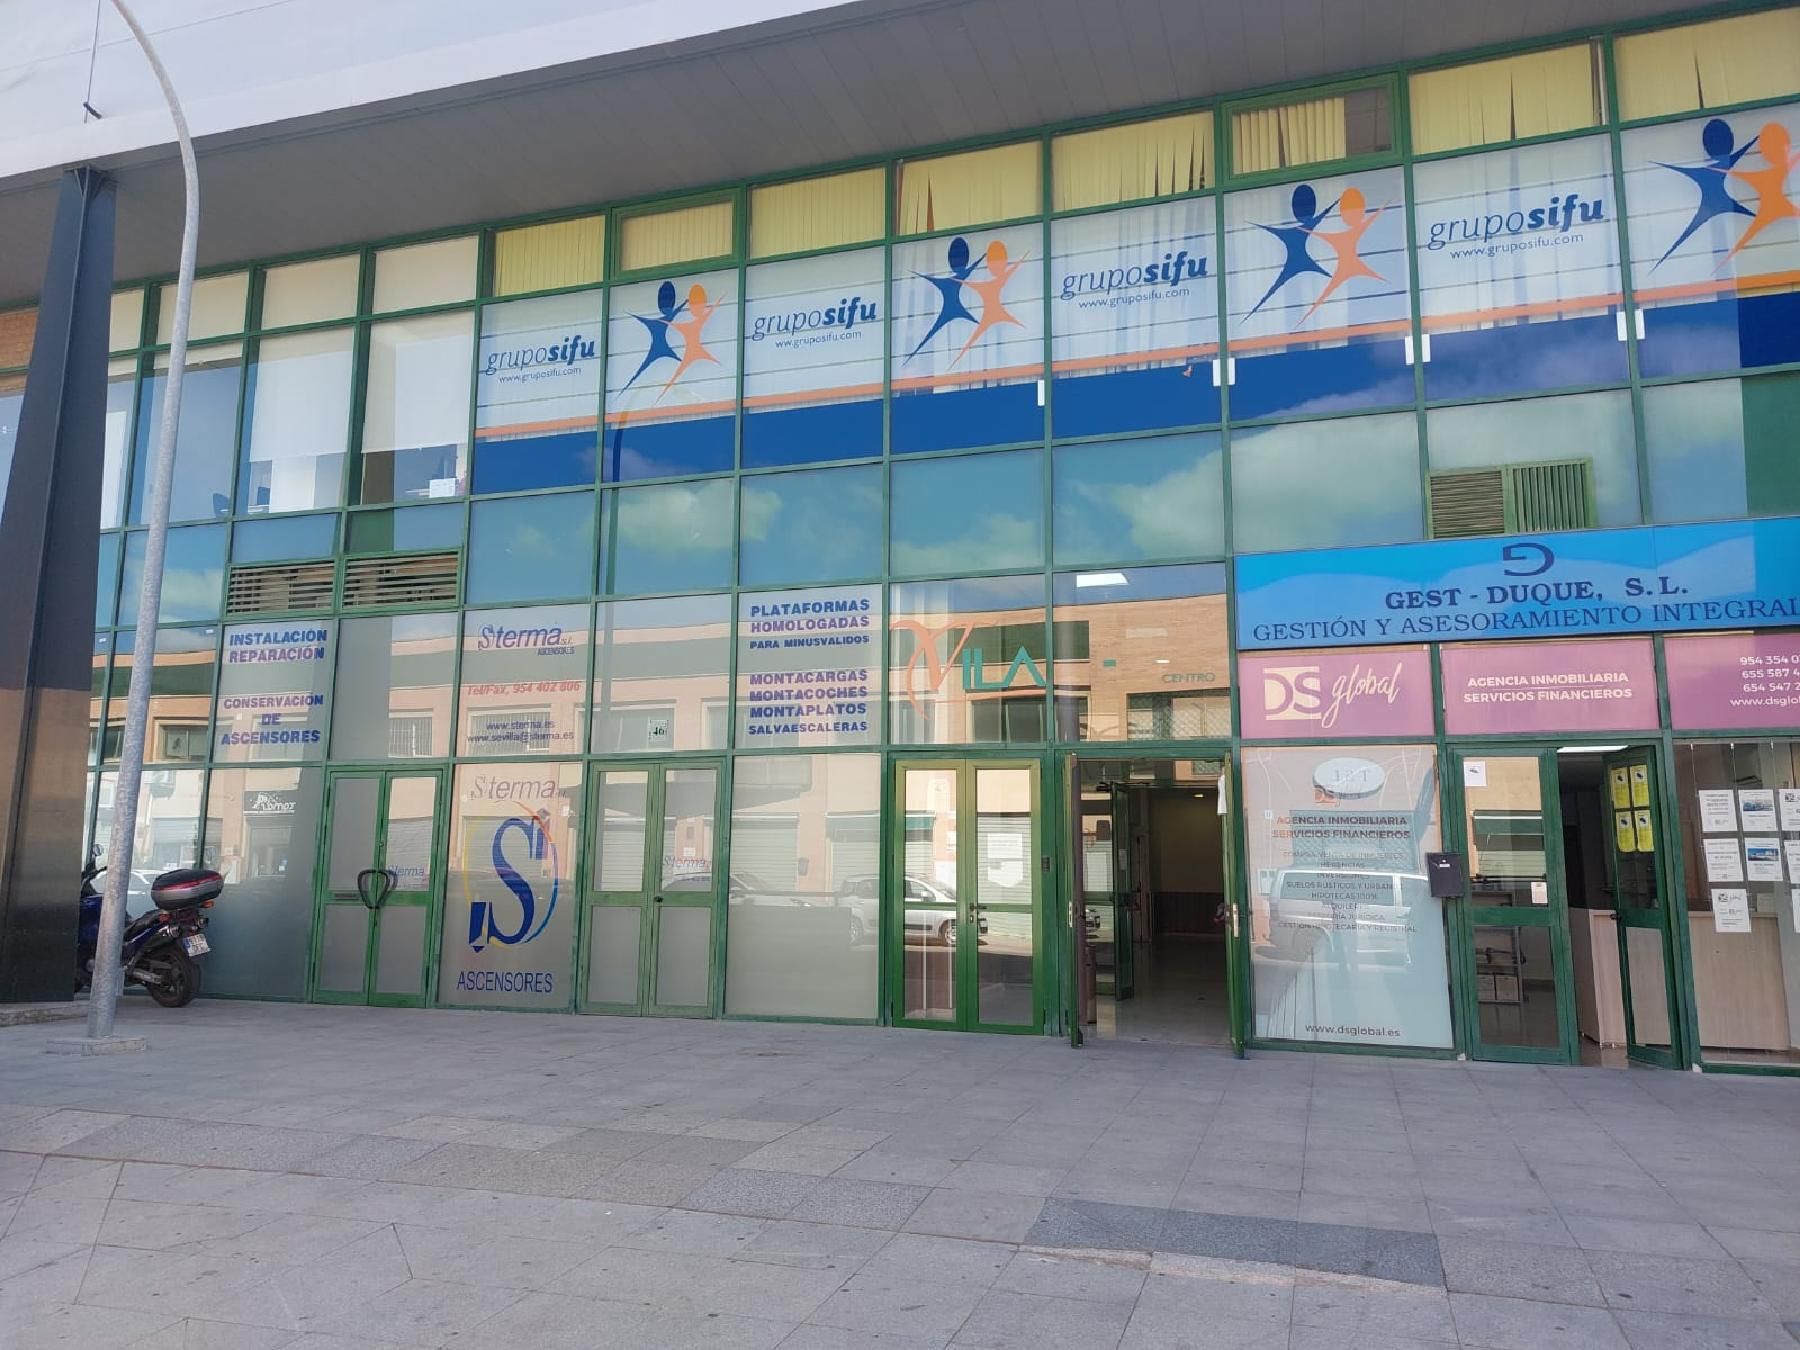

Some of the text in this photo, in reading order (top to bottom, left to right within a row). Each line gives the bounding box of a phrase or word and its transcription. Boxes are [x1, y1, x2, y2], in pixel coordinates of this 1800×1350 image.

[1427, 194, 1604, 251] gruposifu
[1450, 233, 1584, 259] www.gruposifu.com
[1060, 251, 1208, 300] gruposifu
[1079, 287, 1190, 308] www.gruposifu.com
[752, 296, 877, 341] gruposifu
[486, 335, 594, 375] gruposifu
[498, 367, 582, 384] www.gruposifu.com
[1386, 588, 1461, 610] GEST
[1487, 581, 1603, 605] DUQUE,
[751, 599, 870, 617] PLATAFORMAS
[751, 615, 870, 633] HOMOLOGADAS
[1253, 615, 1367, 641] GESTIÓN
[1376, 618, 1392, 636] Y
[1401, 604, 1641, 634] ASESORAMIENTO
[230, 629, 328, 646] INSTALACIÓN
[478, 624, 562, 650] Sterma
[750, 635, 870, 649] PARA MINUSVALIDOS
[229, 645, 325, 663] REPARACIÓN
[1740, 655, 1800, 665] 954 354 0
[750, 669, 868, 685] MONTACARGAS
[1468, 672, 1629, 687] AGENCIA INMOBILIARIA
[1742, 669, 1764, 679] 655
[750, 686, 868, 701] MONTACOCHES
[1263, 662, 1403, 728] DS global
[1463, 688, 1632, 703] SERVICIOS FINANCIEROS
[1743, 683, 1765, 692] 654
[1769, 682, 1790, 691] 547
[1729, 696, 1800, 707] www.dsglo
[261, 713, 282, 725] DE
[751, 703, 867, 718] MONTAPLATOS
[749, 721, 868, 735] SALVAESCALERAS
[221, 730, 321, 745] ASCENSORES
[470, 775, 556, 800] Sterma
[1328, 816, 1408, 825] INMOBILIARIA
[1333, 829, 1410, 838] FINANCIEROS
[457, 970, 553, 993] ASCENSORES
[1305, 1024, 1401, 1037] www.dsglobal.es
